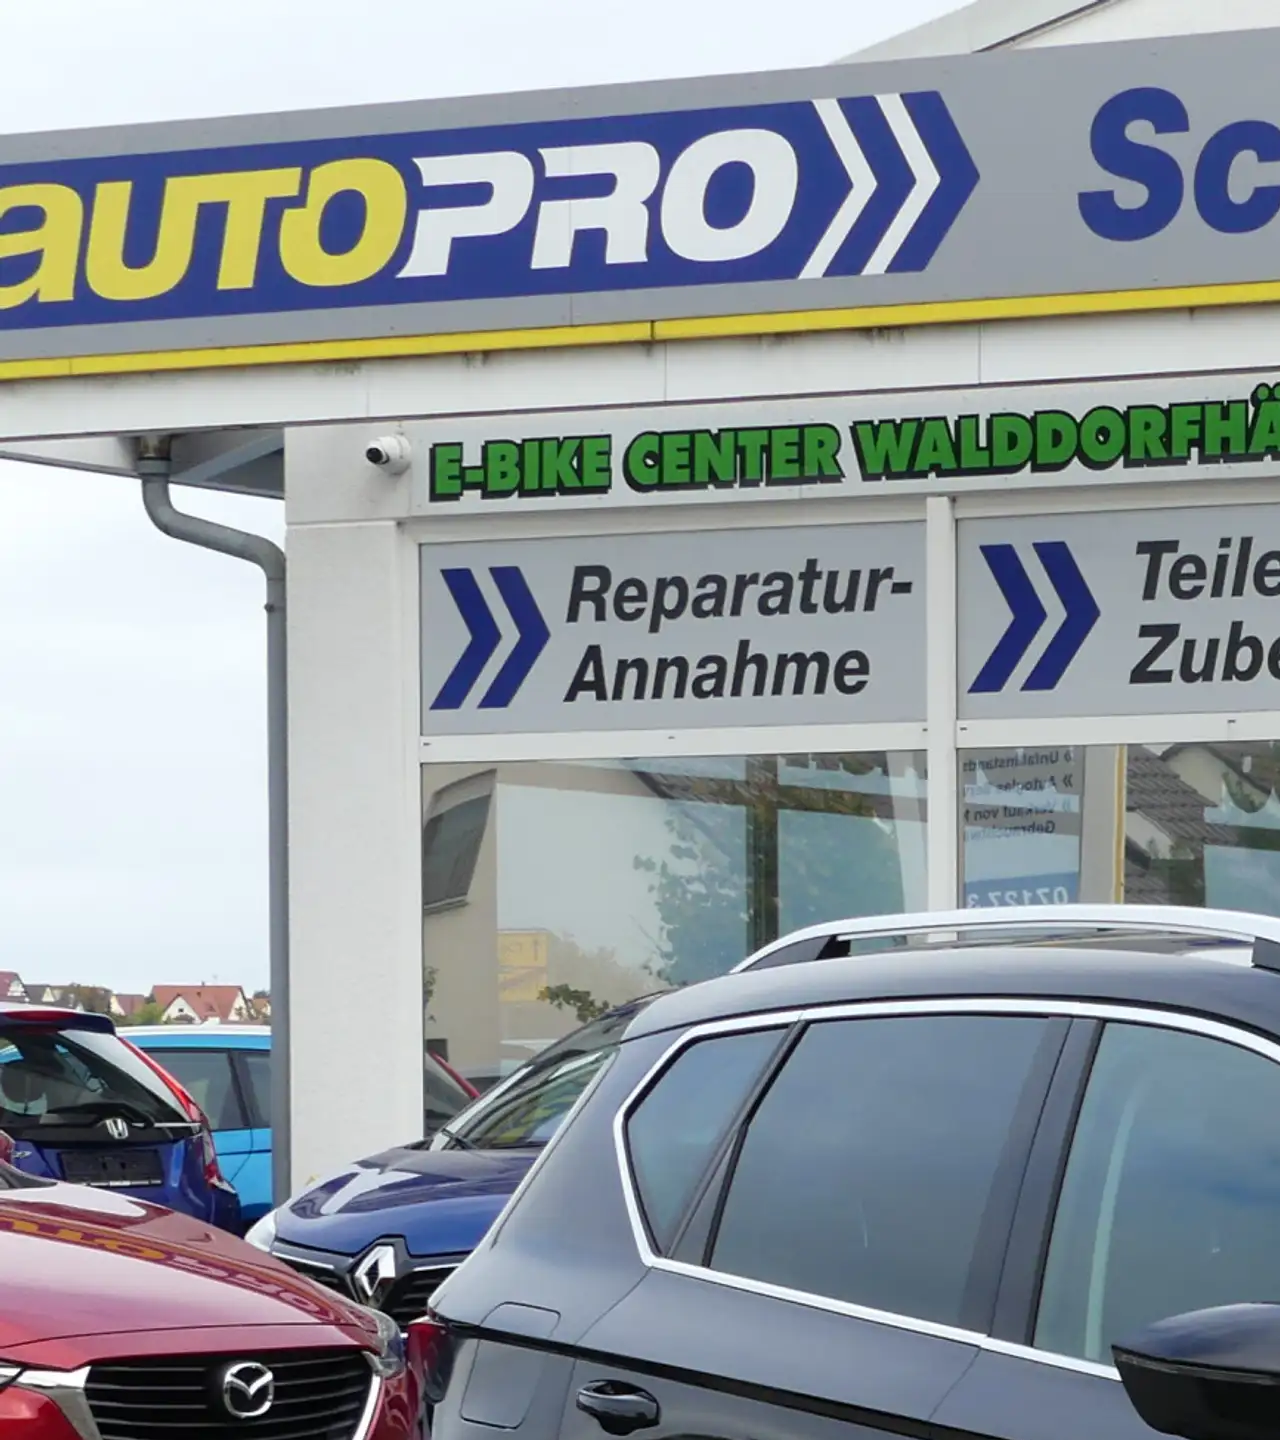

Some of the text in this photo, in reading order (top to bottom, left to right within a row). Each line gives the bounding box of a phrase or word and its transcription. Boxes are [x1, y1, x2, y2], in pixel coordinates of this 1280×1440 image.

[429, 434, 612, 502] E-BIKE
[623, 422, 846, 492] CENTER
[565, 557, 913, 634] Reparatur-
[562, 639, 871, 703] Annahme
